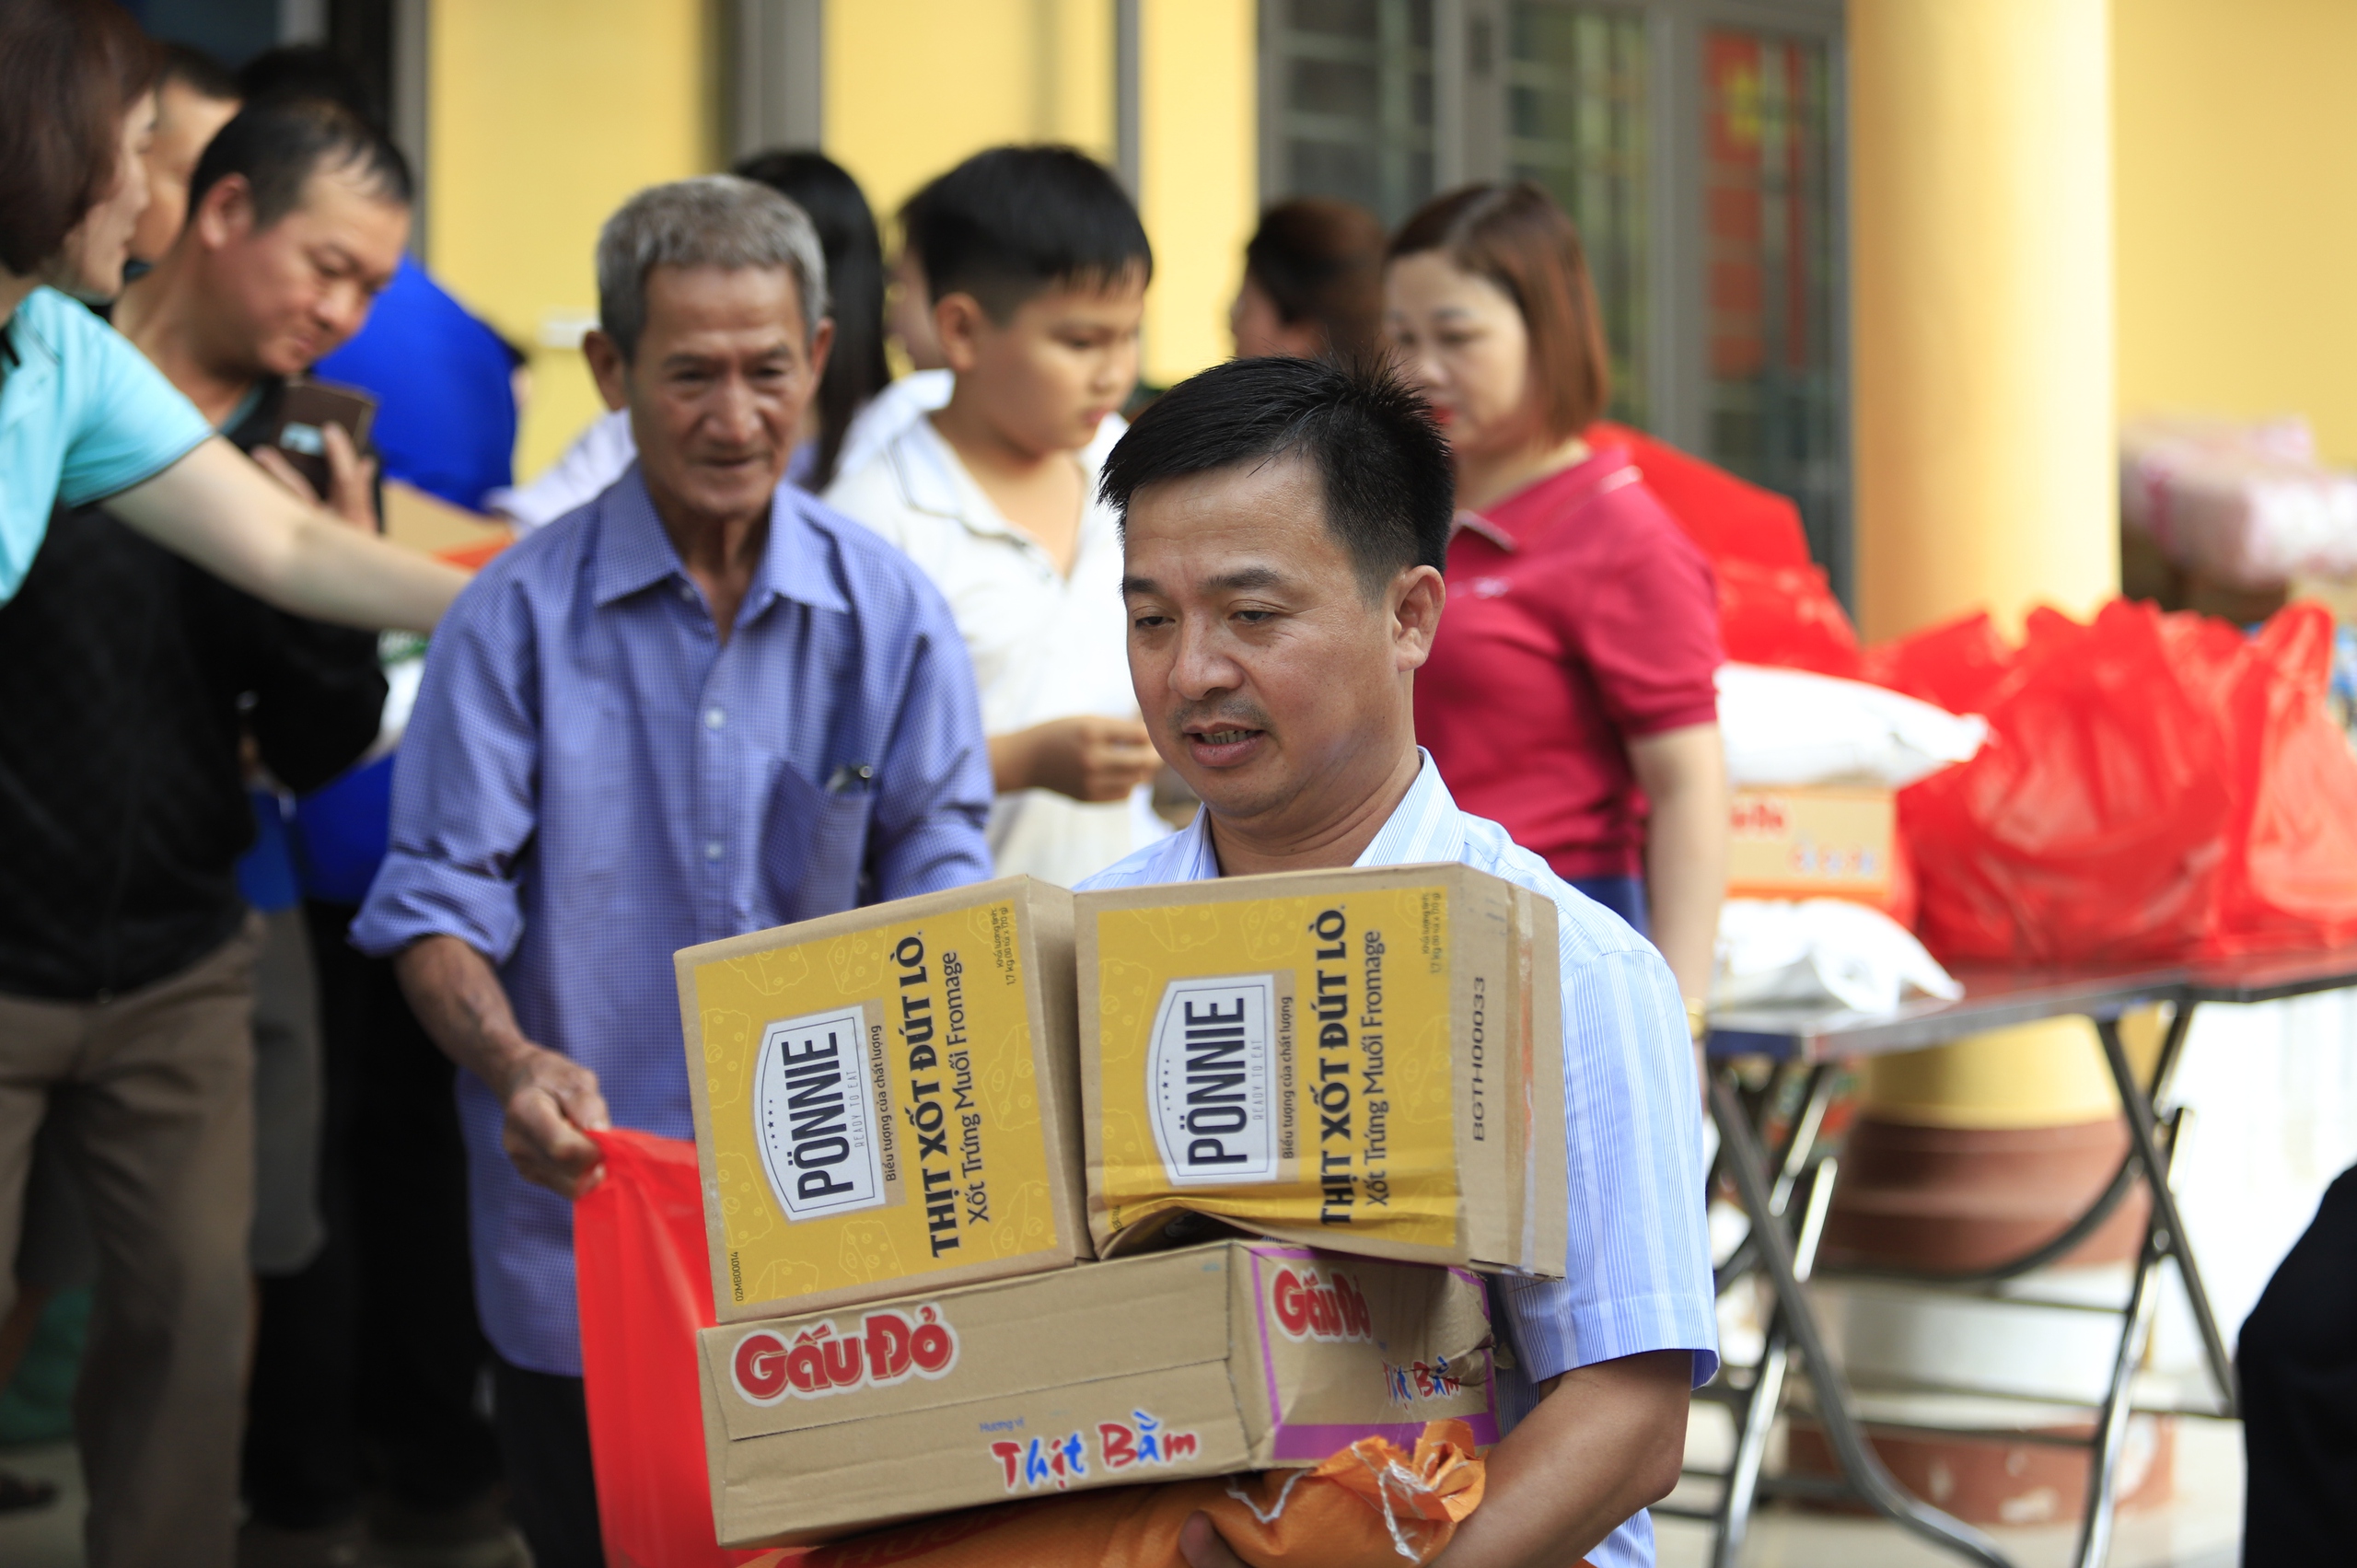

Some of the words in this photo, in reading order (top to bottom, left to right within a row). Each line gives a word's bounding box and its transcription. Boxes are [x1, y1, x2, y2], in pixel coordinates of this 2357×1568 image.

[1005, 959, 1015, 972] kg
[1361, 931, 1386, 1028] Fromage
[942, 951, 967, 1046] Fromage
[1279, 996, 1292, 1033] lượng
[1310, 970, 1349, 1050] ĐÚT
[870, 1025, 883, 1061] lượng
[899, 995, 937, 1072] ĐÚT
[1250, 1040, 1263, 1058] EAT
[1279, 1035, 1292, 1063] chất
[871, 1063, 885, 1089] chất
[1251, 1065, 1262, 1078] TO
[1280, 1065, 1292, 1087] của
[1471, 976, 1485, 1142] BGTH00033
[846, 1070, 859, 1088] EAT
[1179, 998, 1248, 1166] PÖNNIE
[781, 1032, 853, 1200] PÖNNIE
[850, 1095, 860, 1108] TO
[876, 1091, 888, 1112] của
[1252, 1086, 1264, 1121] READY
[1281, 1090, 1295, 1128] tượng
[1309, 1057, 1351, 1144] XỐT
[853, 1114, 865, 1148] READY
[880, 1115, 894, 1151] tượng
[904, 1079, 948, 1162] XỐT
[1364, 1100, 1389, 1166] Trứng
[959, 1113, 982, 1179] Trứng
[1280, 1131, 1295, 1159] Biểu
[882, 1154, 896, 1181] Biểu
[964, 1180, 990, 1225] Xốt
[1320, 1151, 1358, 1225] THỊT
[1364, 1169, 1389, 1206] Xốt
[922, 1168, 960, 1258] THỊT
[730, 1251, 744, 1302] 02MB00014
[991, 1433, 1085, 1489] Thịt
[1098, 1411, 1196, 1469] Bằm
